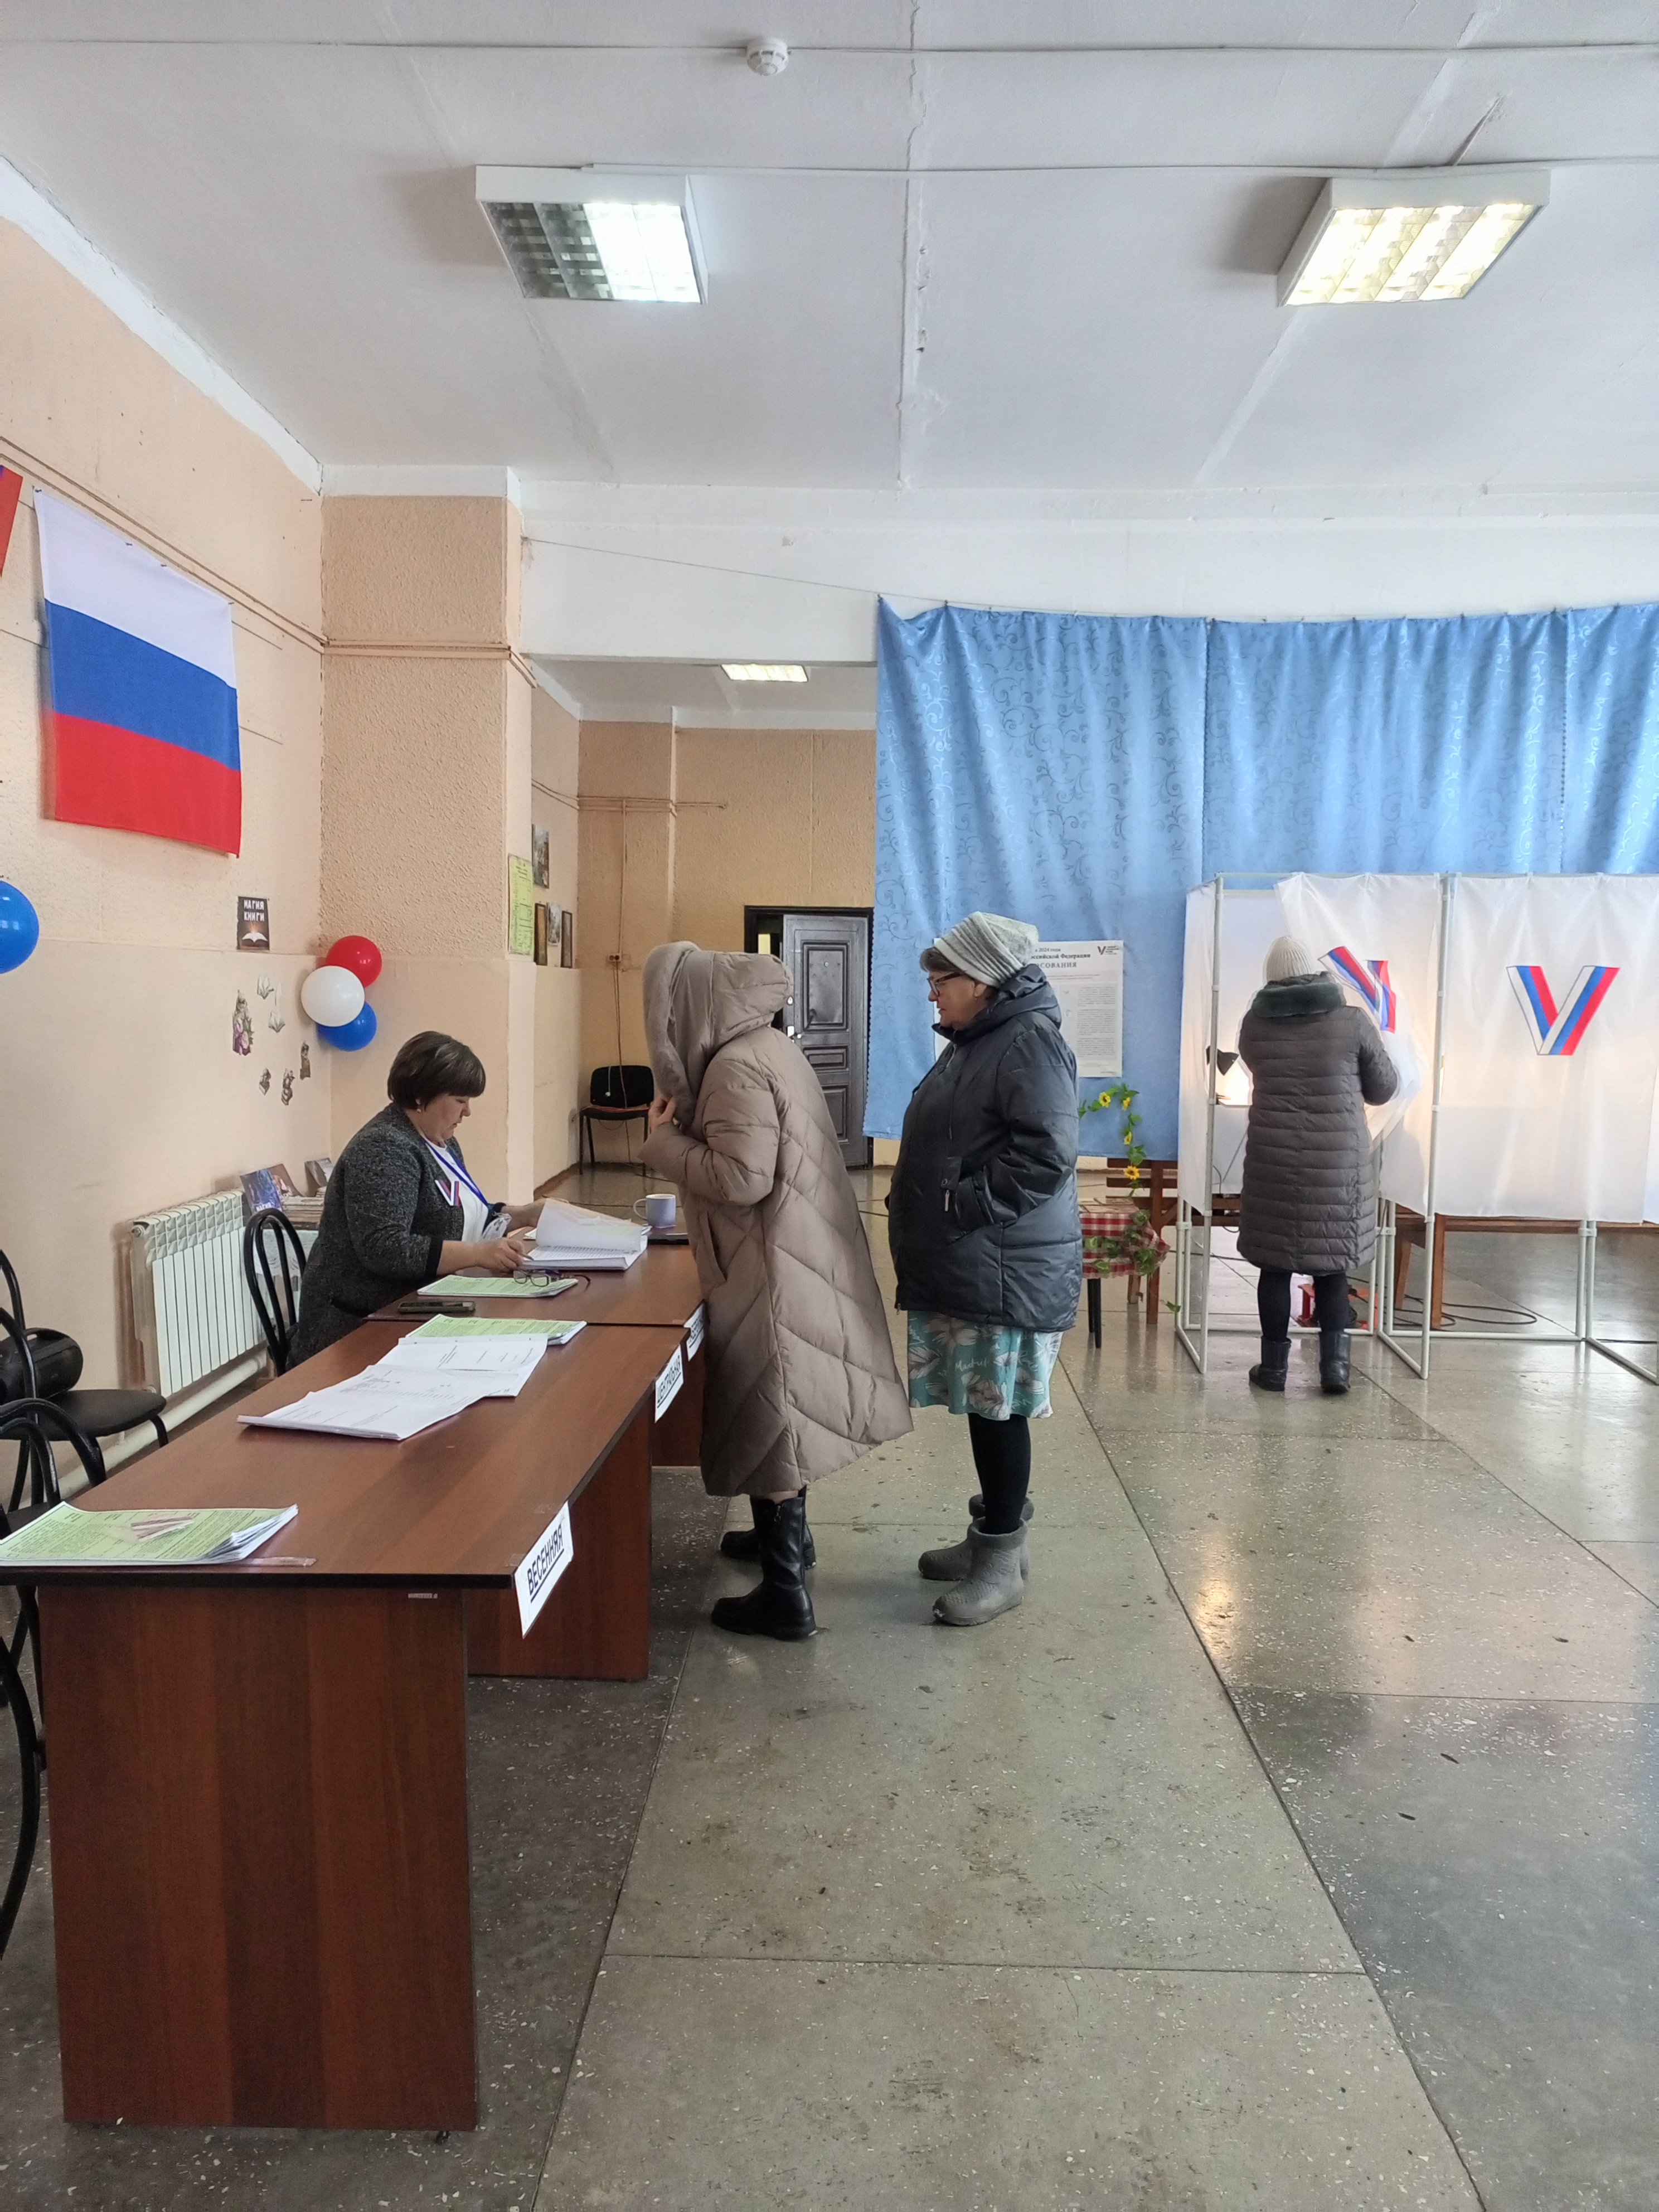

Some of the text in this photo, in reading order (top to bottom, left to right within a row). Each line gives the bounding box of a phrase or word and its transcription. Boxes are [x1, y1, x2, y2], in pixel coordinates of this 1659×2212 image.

[244, 899, 264, 910] МАГИЯ
[244, 911, 265, 921] КНИГИ
[527, 1524, 564, 1596] ВЕСЕННЯЯ
